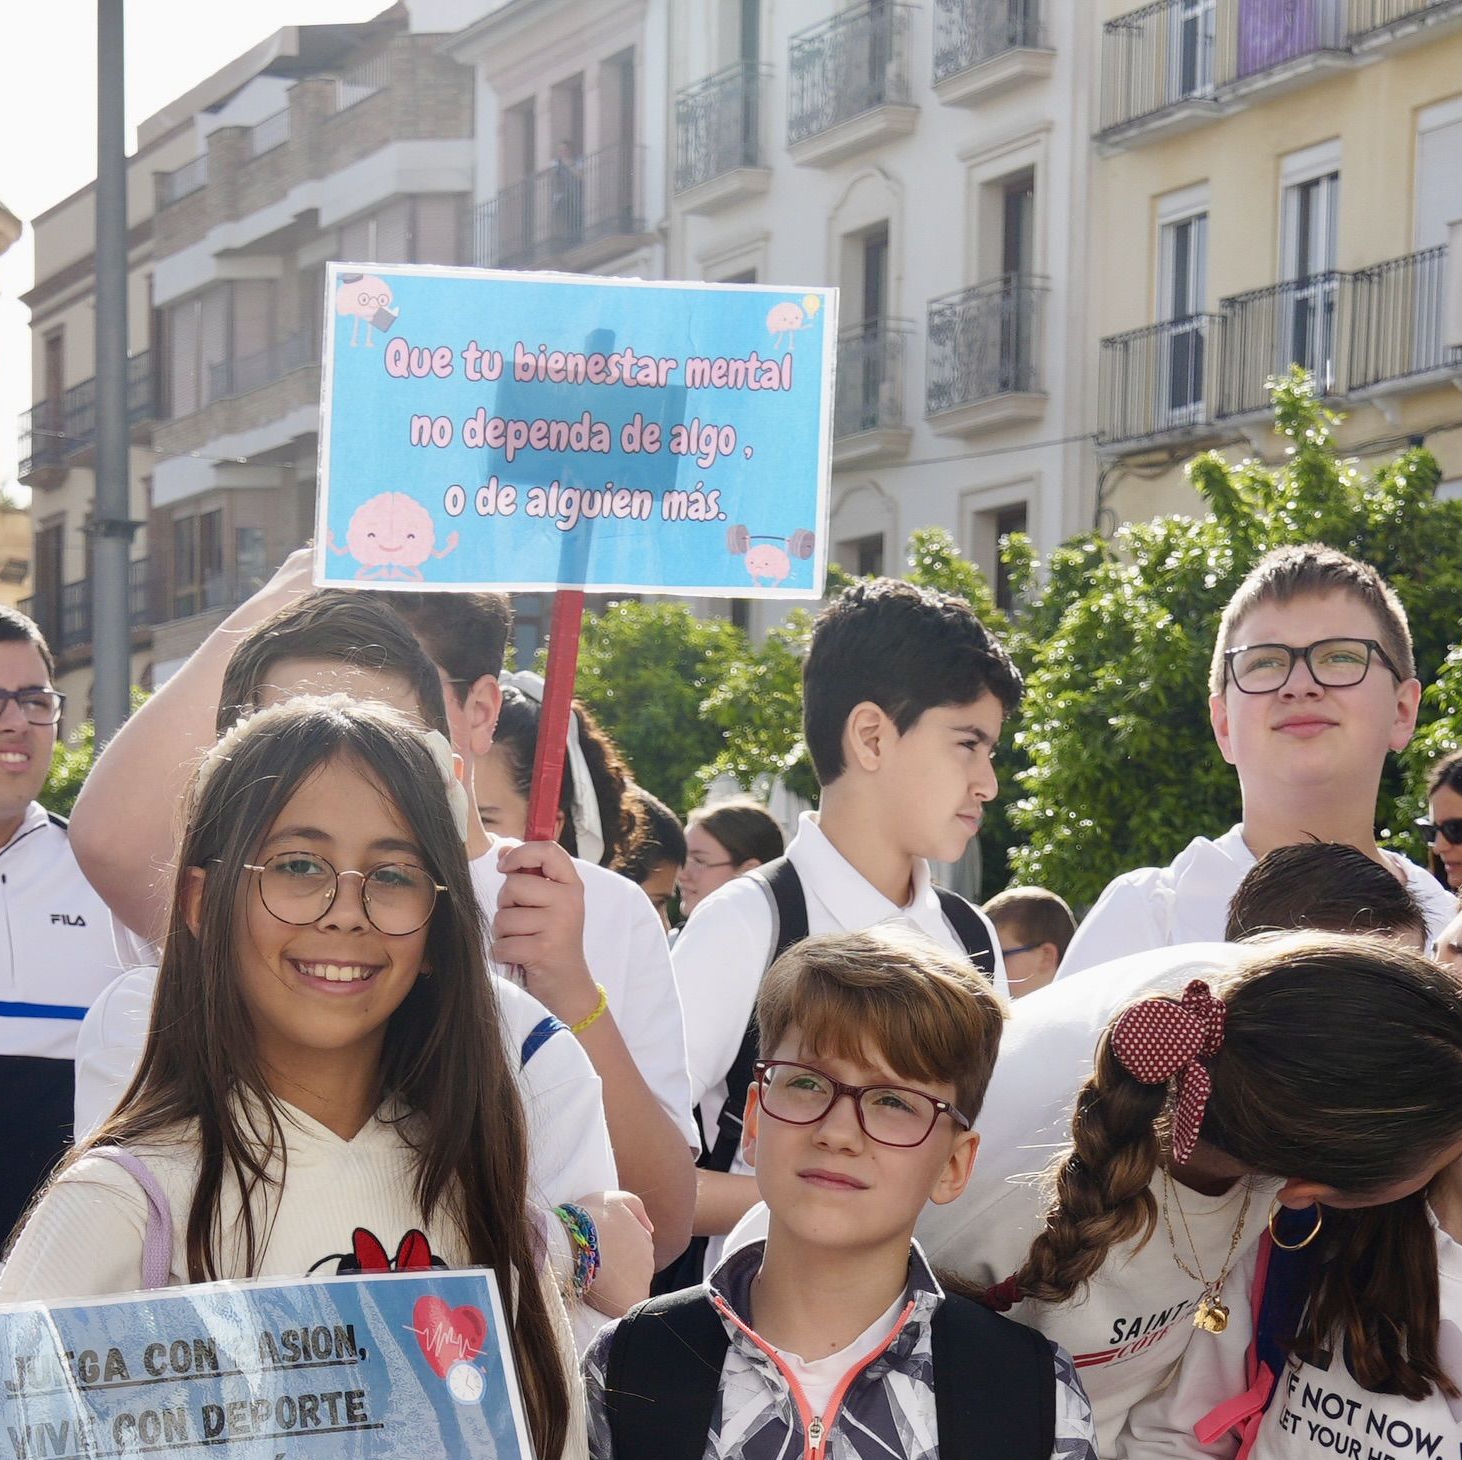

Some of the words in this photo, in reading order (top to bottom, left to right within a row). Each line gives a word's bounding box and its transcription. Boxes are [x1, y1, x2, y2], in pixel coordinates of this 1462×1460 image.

[385, 336, 454, 379] Que
[462, 340, 503, 380] tu
[513, 341, 678, 388] bienestar
[685, 351, 793, 392] mental
[410, 413, 453, 449] no
[462, 406, 610, 463] dependa
[620, 412, 661, 454] de
[444, 484, 466, 517] o
[475, 475, 517, 517] de
[525, 481, 652, 531] alguien
[661, 481, 727, 522] más.
[51, 914, 86, 926] FILA
[144, 1338, 220, 1377] CON
[237, 1324, 367, 1368] ASION,
[113, 1407, 188, 1449] CON
[202, 1389, 368, 1438] DEPORTE
[1301, 1382, 1362, 1426] NOT
